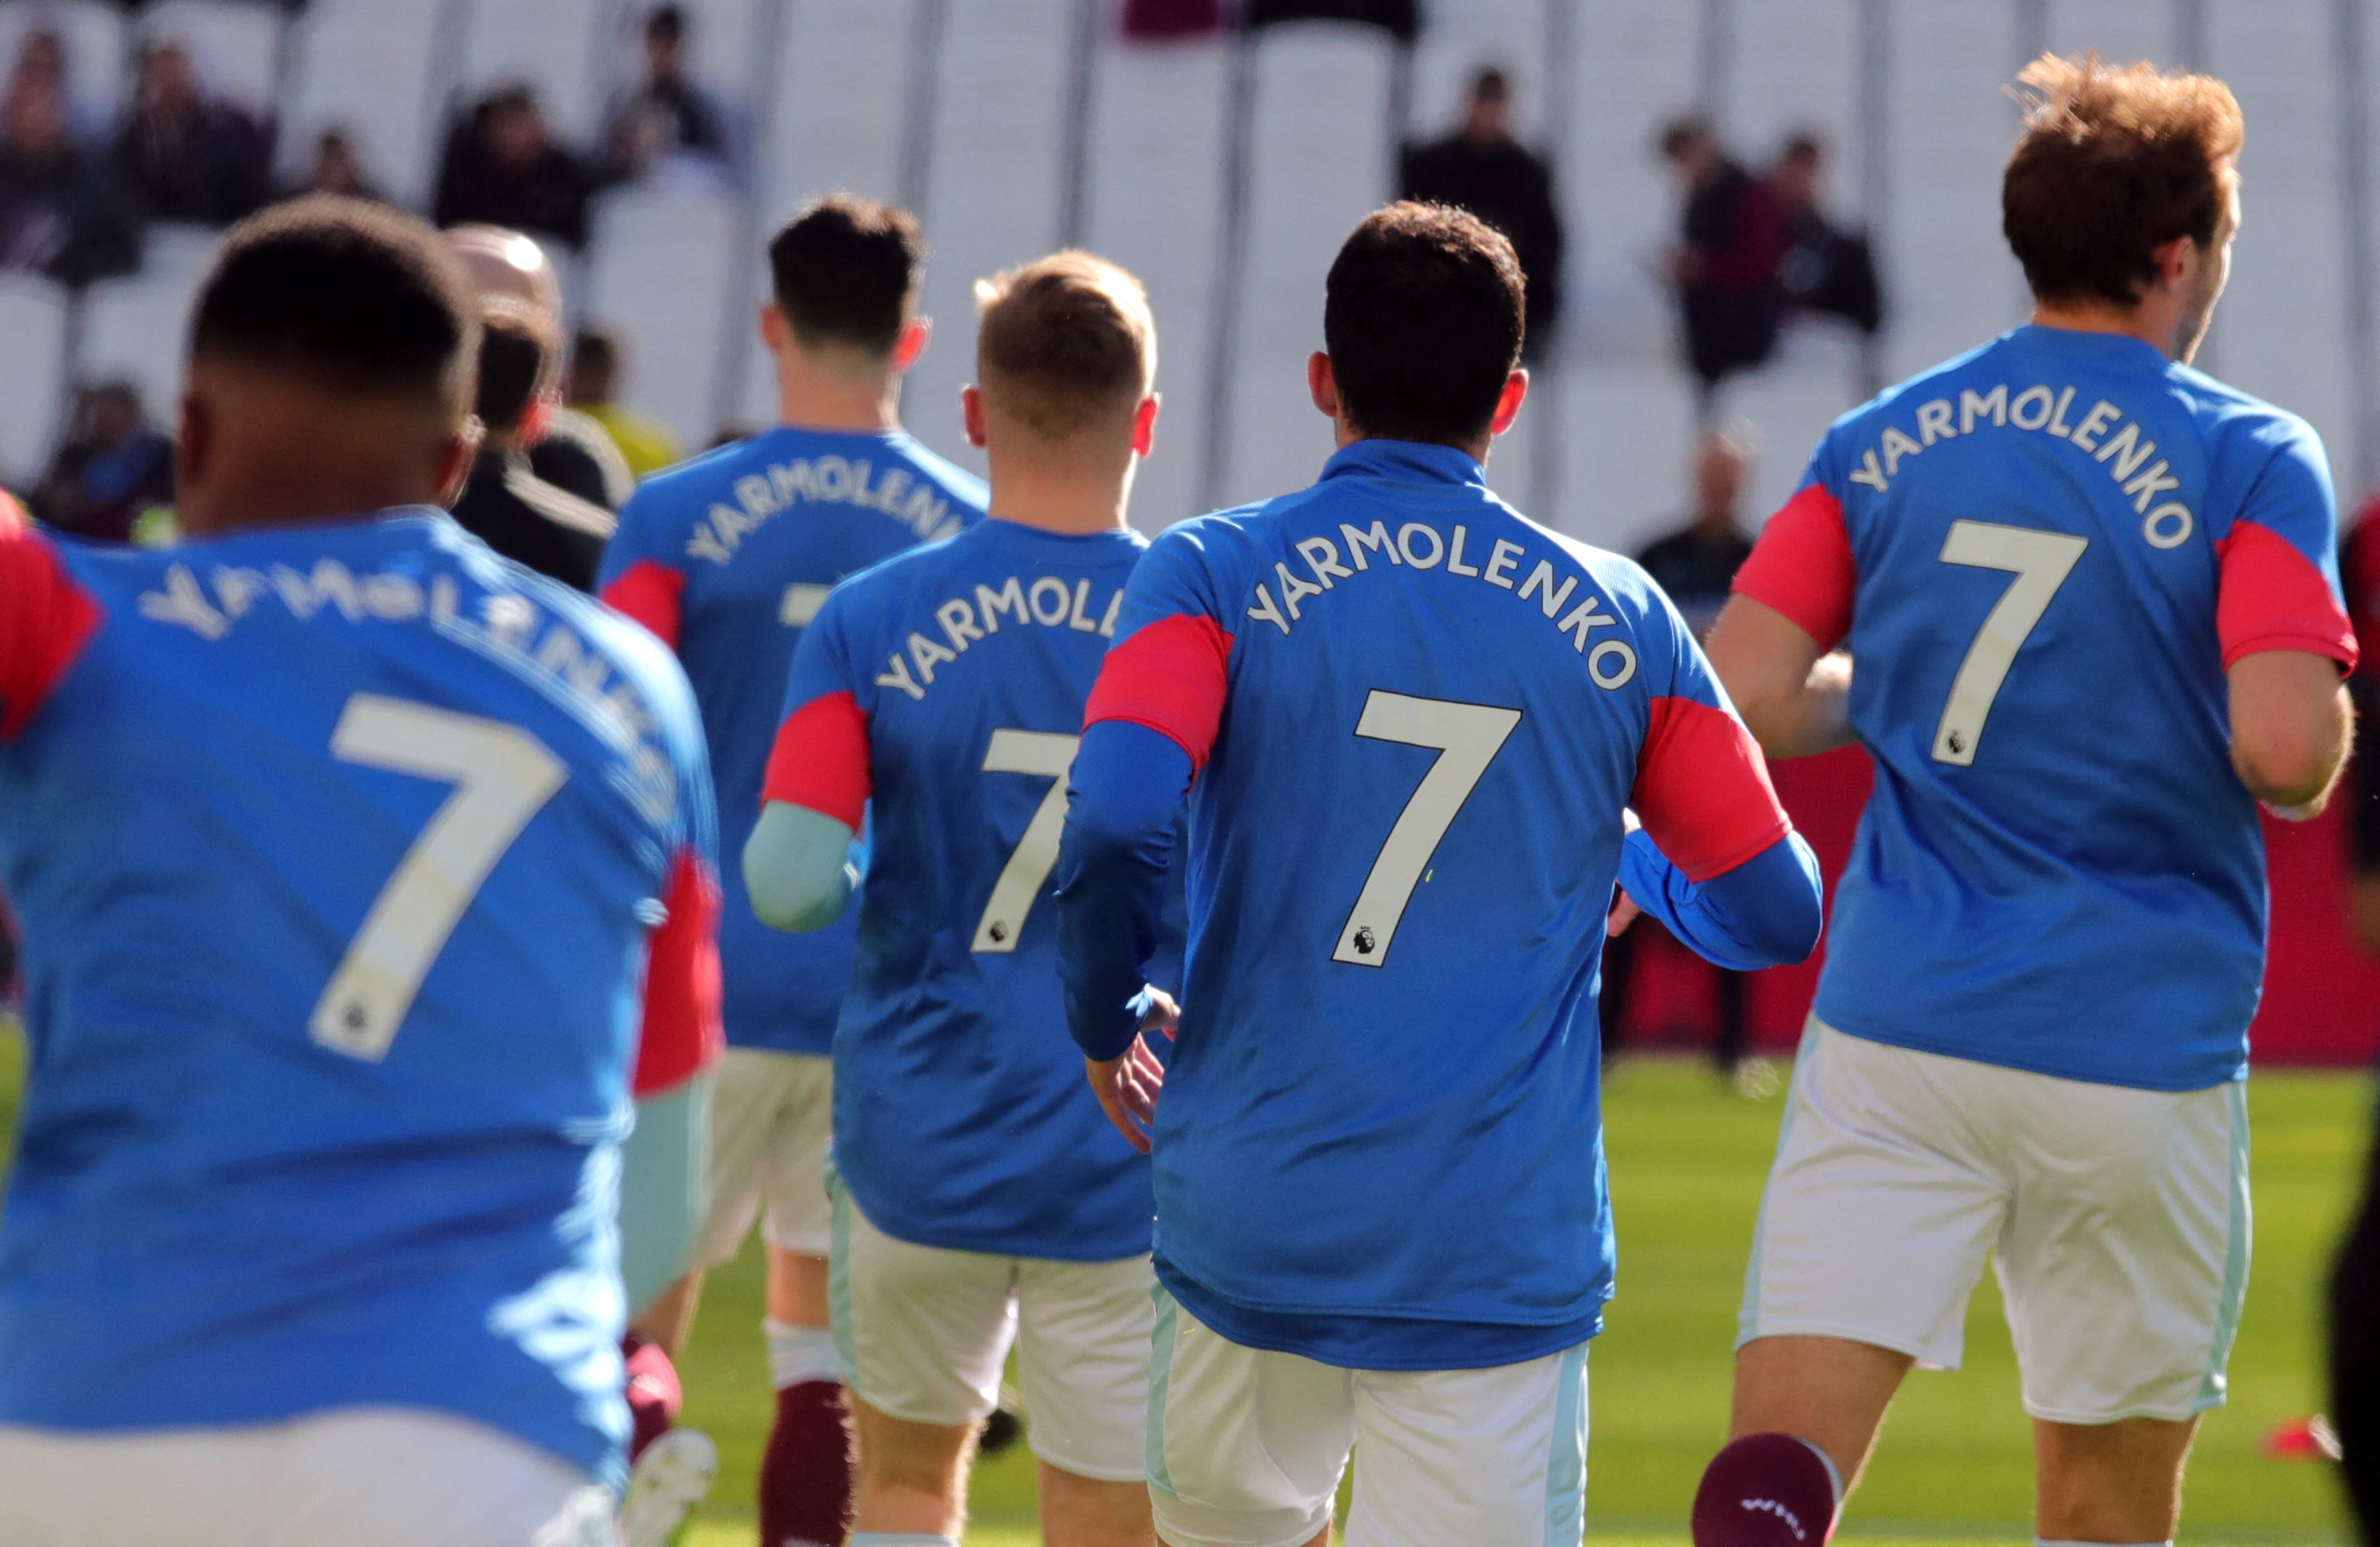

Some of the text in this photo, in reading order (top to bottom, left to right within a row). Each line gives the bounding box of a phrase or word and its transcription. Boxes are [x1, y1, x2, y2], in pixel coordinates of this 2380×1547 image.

[1850, 383, 2193, 549] YARMOLENKO
[1247, 520, 1638, 691] YARMOLENKO
[1931, 518, 2090, 766] 7
[306, 692, 571, 1063] 7
[970, 728, 1082, 953] 7
[1331, 687, 1523, 969] 7
